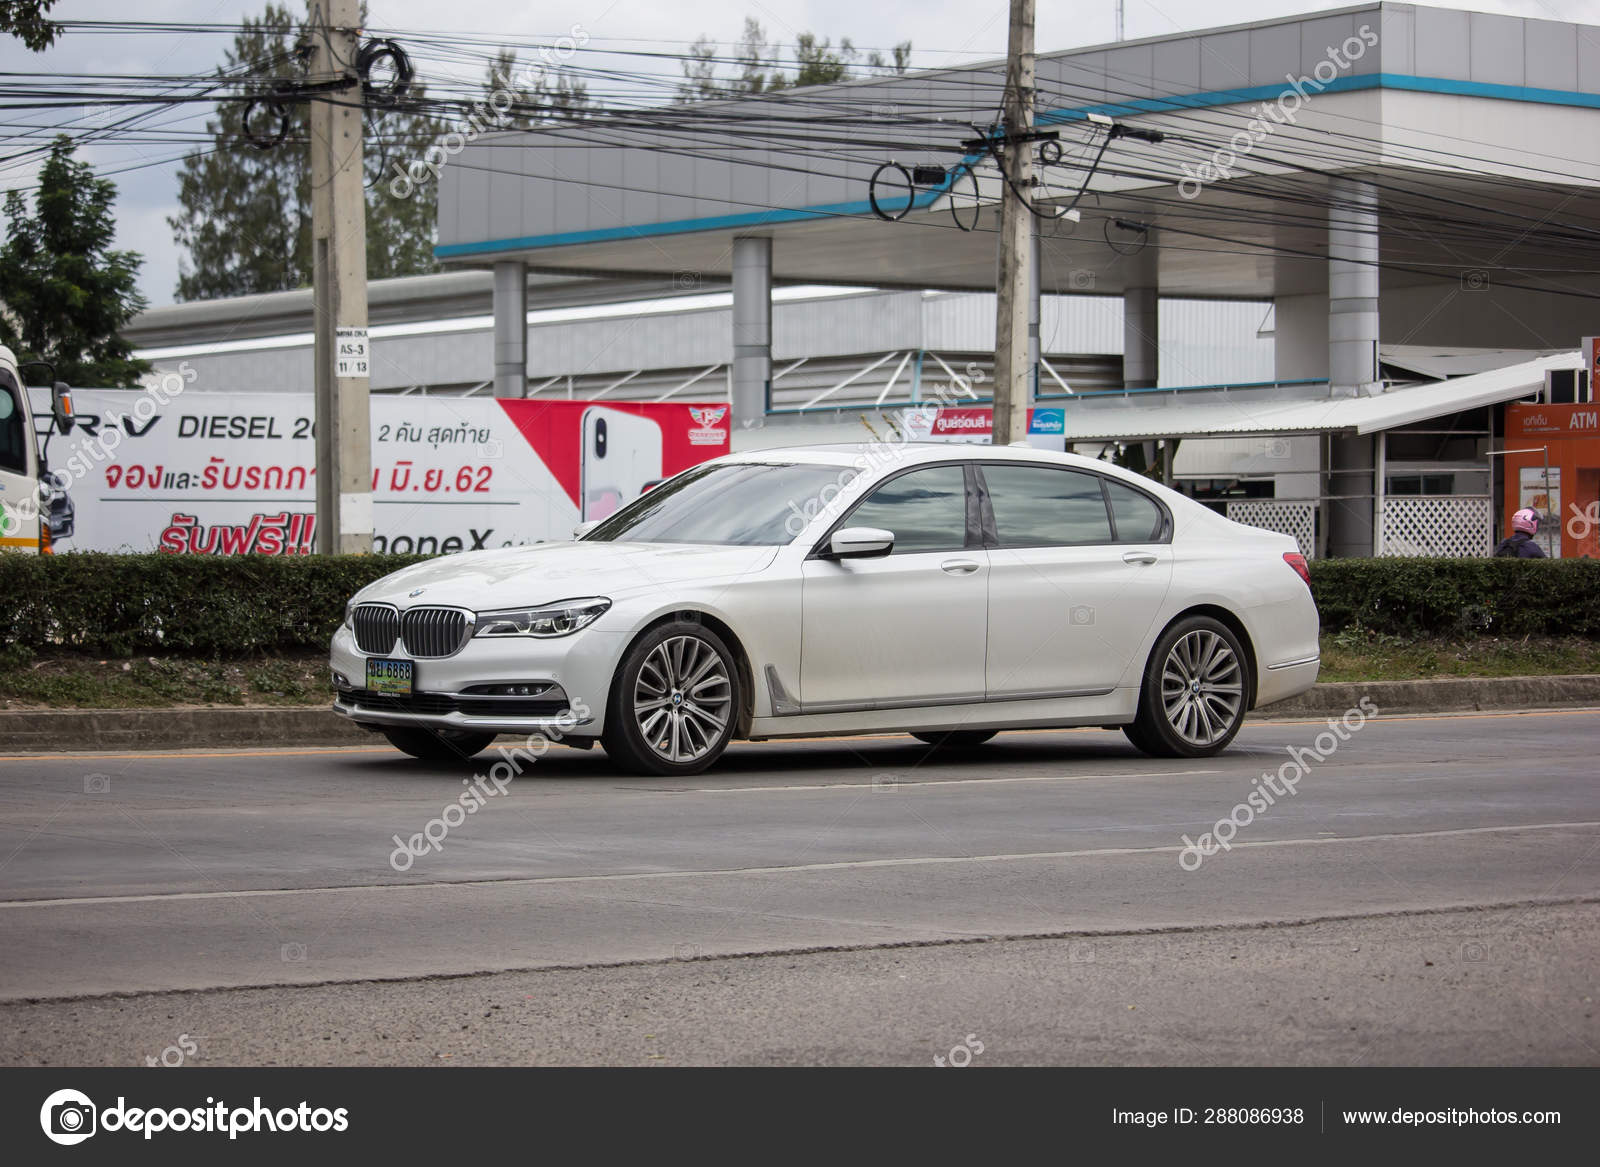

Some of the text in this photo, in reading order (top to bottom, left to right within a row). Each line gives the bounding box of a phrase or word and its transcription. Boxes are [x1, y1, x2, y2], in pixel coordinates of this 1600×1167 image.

[341, 344, 364, 355] AS-3
[178, 416, 283, 439] DIESEL
[378, 424, 391, 442] 2
[396, 421, 422, 442] คัน
[427, 421, 490, 450] สุดท้าย
[1569, 412, 1598, 430] ATM
[390, 461, 493, 493] มิ.ย.62
[159, 512, 316, 556] รับฟรี!!
[387, 663, 410, 679] 6868
